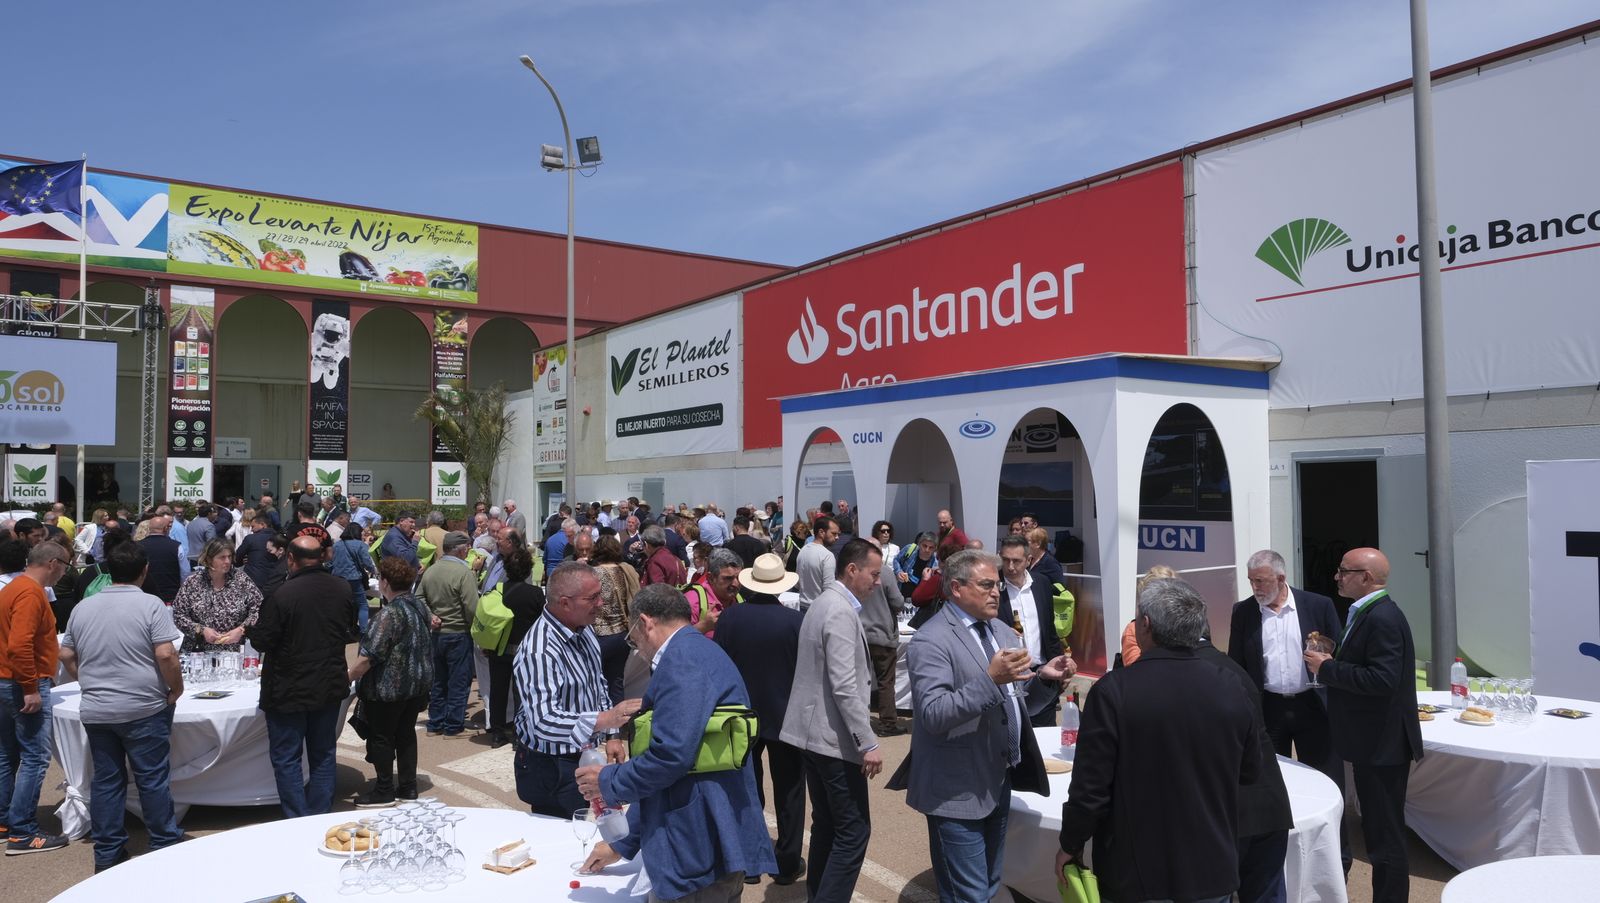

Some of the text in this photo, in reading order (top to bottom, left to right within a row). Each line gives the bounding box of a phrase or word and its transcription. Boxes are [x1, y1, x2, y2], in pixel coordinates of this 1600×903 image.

[434, 224, 454, 235] Feria
[310, 239, 326, 247] abril
[327, 241, 349, 249] 2022
[836, 262, 1085, 356] Santander
[638, 328, 732, 375] El Plantel
[638, 362, 730, 392] SEMILLEROS
[171, 397, 201, 405] Pioneros
[315, 402, 344, 410] HAIFA
[171, 404, 211, 412] Nutrigación
[324, 412, 335, 420] IN
[618, 409, 721, 433] EL MEJOR INJERTO PARA SU COSECHA
[312, 421, 346, 430] SPACE
[852, 431, 883, 445] CUCN
[12, 485, 47, 497] Haifa
[174, 486, 204, 497] Haifa
[315, 487, 336, 497] Haif
[437, 487, 461, 497] Haifa
[1139, 527, 1197, 550] UCN
